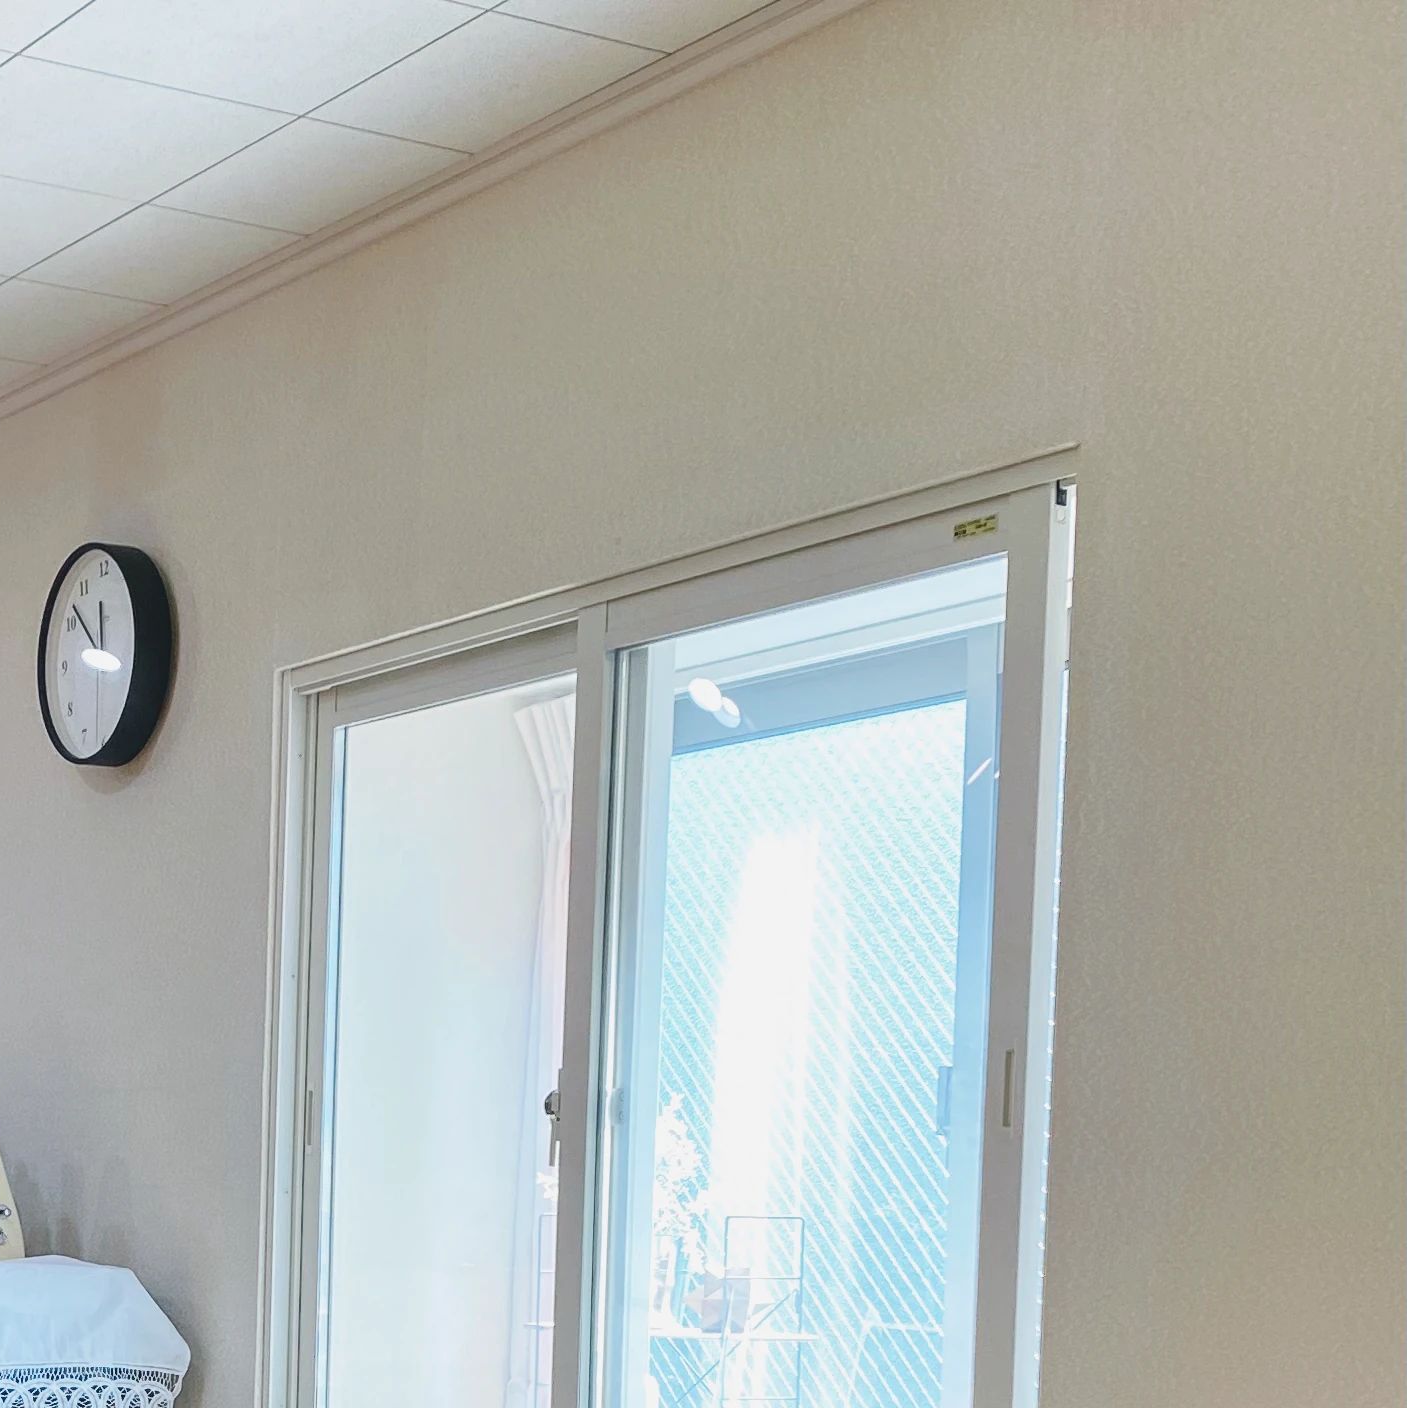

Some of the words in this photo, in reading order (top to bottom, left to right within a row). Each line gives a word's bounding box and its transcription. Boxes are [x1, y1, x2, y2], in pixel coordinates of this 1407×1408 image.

[99, 560, 109, 577] 12
[80, 579, 89, 597] 11
[67, 615, 77, 632] 10
[61, 660, 68, 676] 9
[67, 702, 73, 717] 8
[81, 728, 88, 746] 7
